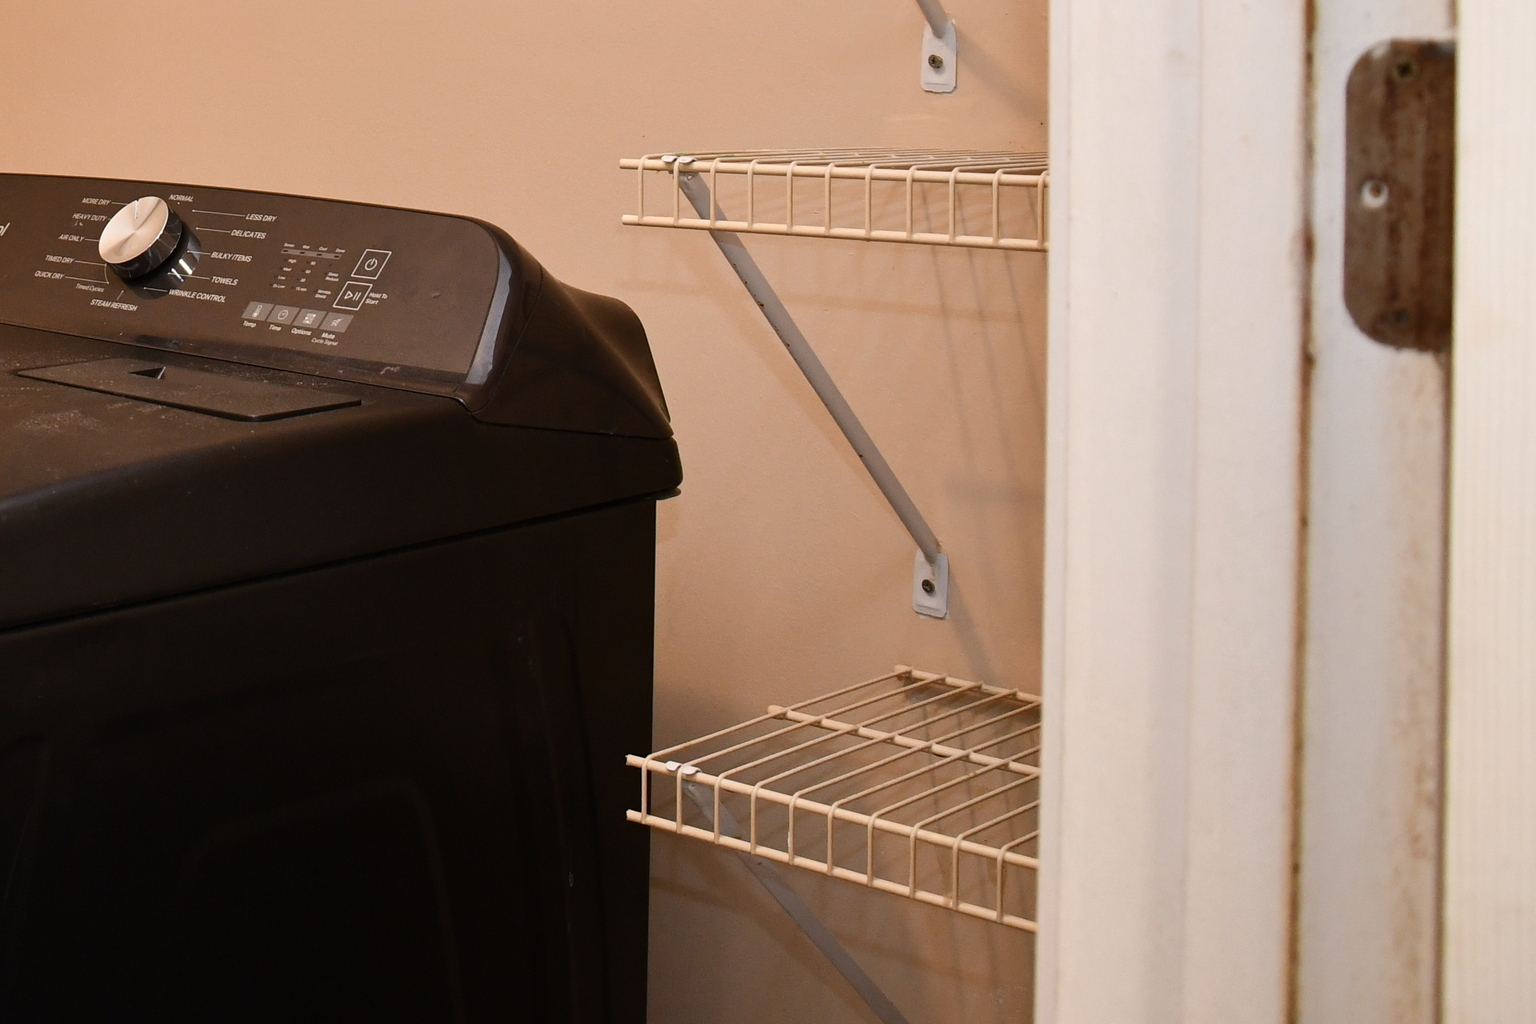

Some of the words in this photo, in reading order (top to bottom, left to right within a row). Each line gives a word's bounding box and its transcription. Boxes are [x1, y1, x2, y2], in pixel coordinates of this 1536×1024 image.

[81, 197, 98, 205] MORE
[98, 198, 111, 206] DRY
[168, 194, 194, 202] NORMAL
[91, 214, 107, 222] DUTY
[245, 213, 262, 221] LESS
[262, 215, 278, 223] DRY
[68, 234, 85, 242] ONLY
[230, 229, 267, 240] DELICATES
[45, 254, 63, 263] TIMED
[62, 256, 75, 264] DRY
[210, 251, 233, 260] BULKY
[231, 253, 253, 263] ITEMS
[34, 270, 52, 279] QUICK
[51, 272, 65, 280] DRY
[211, 276, 239, 286] TOWELS
[75, 283, 89, 291] Timed
[89, 284, 105, 293] Cycles
[168, 289, 198, 299] WRINKLE
[196, 292, 227, 303] CONTROL
[90, 298, 112, 308] STEAM
[110, 301, 139, 312] REFRESH
[268, 324, 282, 332] Time
[291, 327, 312, 336] Options
[311, 337, 324, 345] Cycle
[321, 332, 336, 340] Mute
